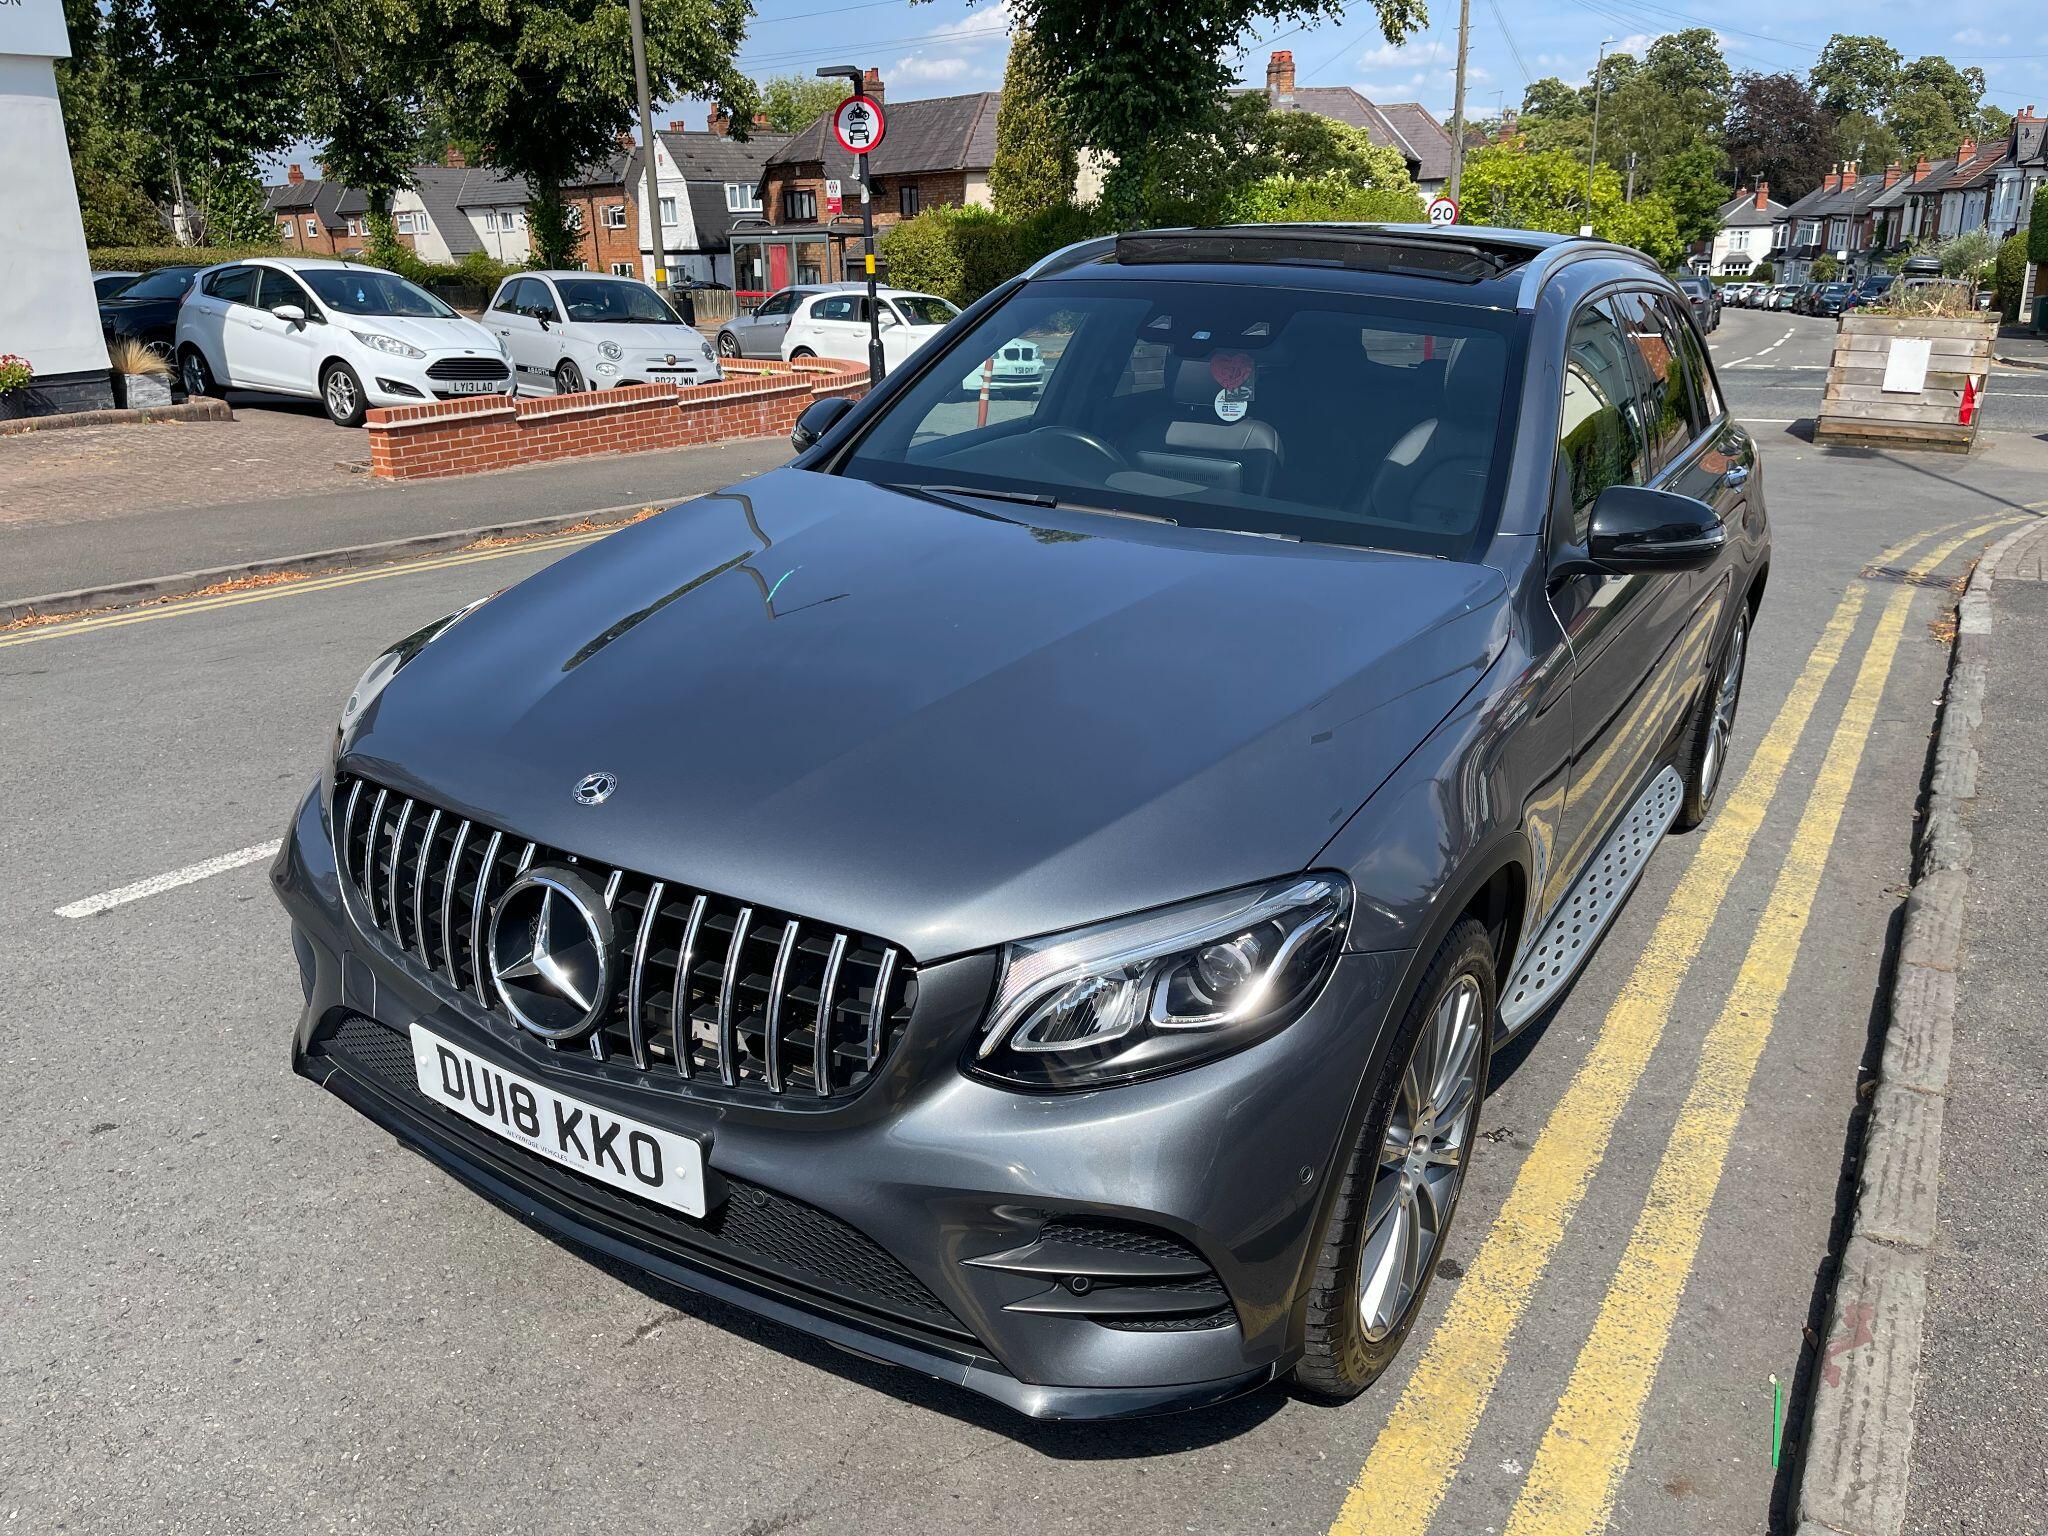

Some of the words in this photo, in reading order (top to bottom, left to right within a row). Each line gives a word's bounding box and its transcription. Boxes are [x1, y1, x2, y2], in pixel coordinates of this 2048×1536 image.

[1433, 208, 1453, 220] 20
[527, 367, 550, 376] ABARTH
[454, 382, 474, 392] LY13
[476, 382, 493, 392] LAO
[679, 377, 694, 386] JWN
[436, 1044, 540, 1138] DU18
[553, 1099, 664, 1188] KKO
[541, 1145, 568, 1162] VEHICLES
